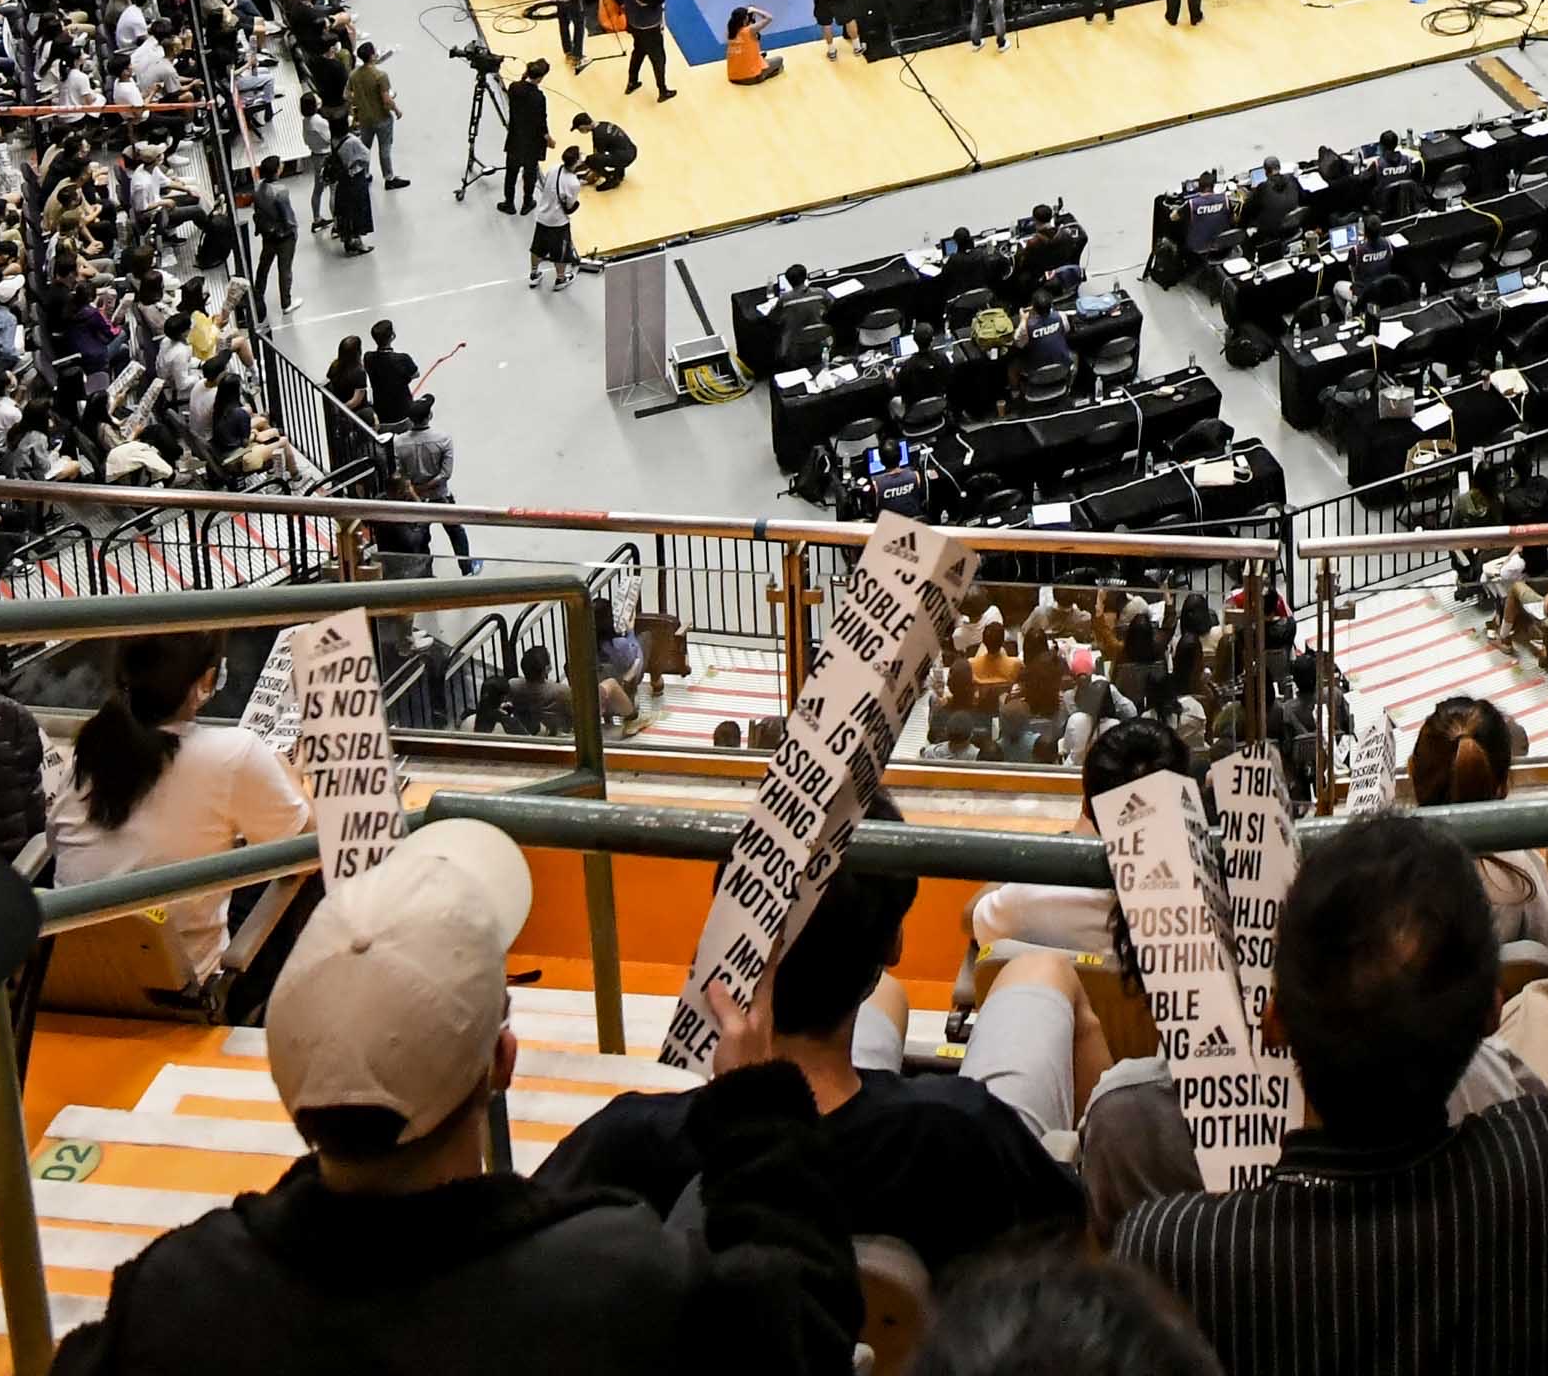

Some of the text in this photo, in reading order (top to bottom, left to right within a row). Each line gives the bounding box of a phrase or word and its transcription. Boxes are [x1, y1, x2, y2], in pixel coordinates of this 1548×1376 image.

[1382, 164, 1409, 177] CTUSF
[1197, 203, 1223, 216] CTUSF
[1362, 250, 1387, 263] CTUSF
[1032, 322, 1060, 339] CTUSF
[883, 481, 914, 500] CTUSF
[882, 543, 919, 564] adidas
[308, 657, 372, 685] IMPO
[303, 689, 377, 720] IS NOT
[824, 721, 857, 756] IS
[314, 767, 386, 799] THING
[1231, 765, 1271, 797] IBLE
[1247, 813, 1264, 844] IS
[334, 849, 357, 878] IS
[1193, 1046, 1236, 1058] adidas
[40, 1144, 95, 1181] D2
